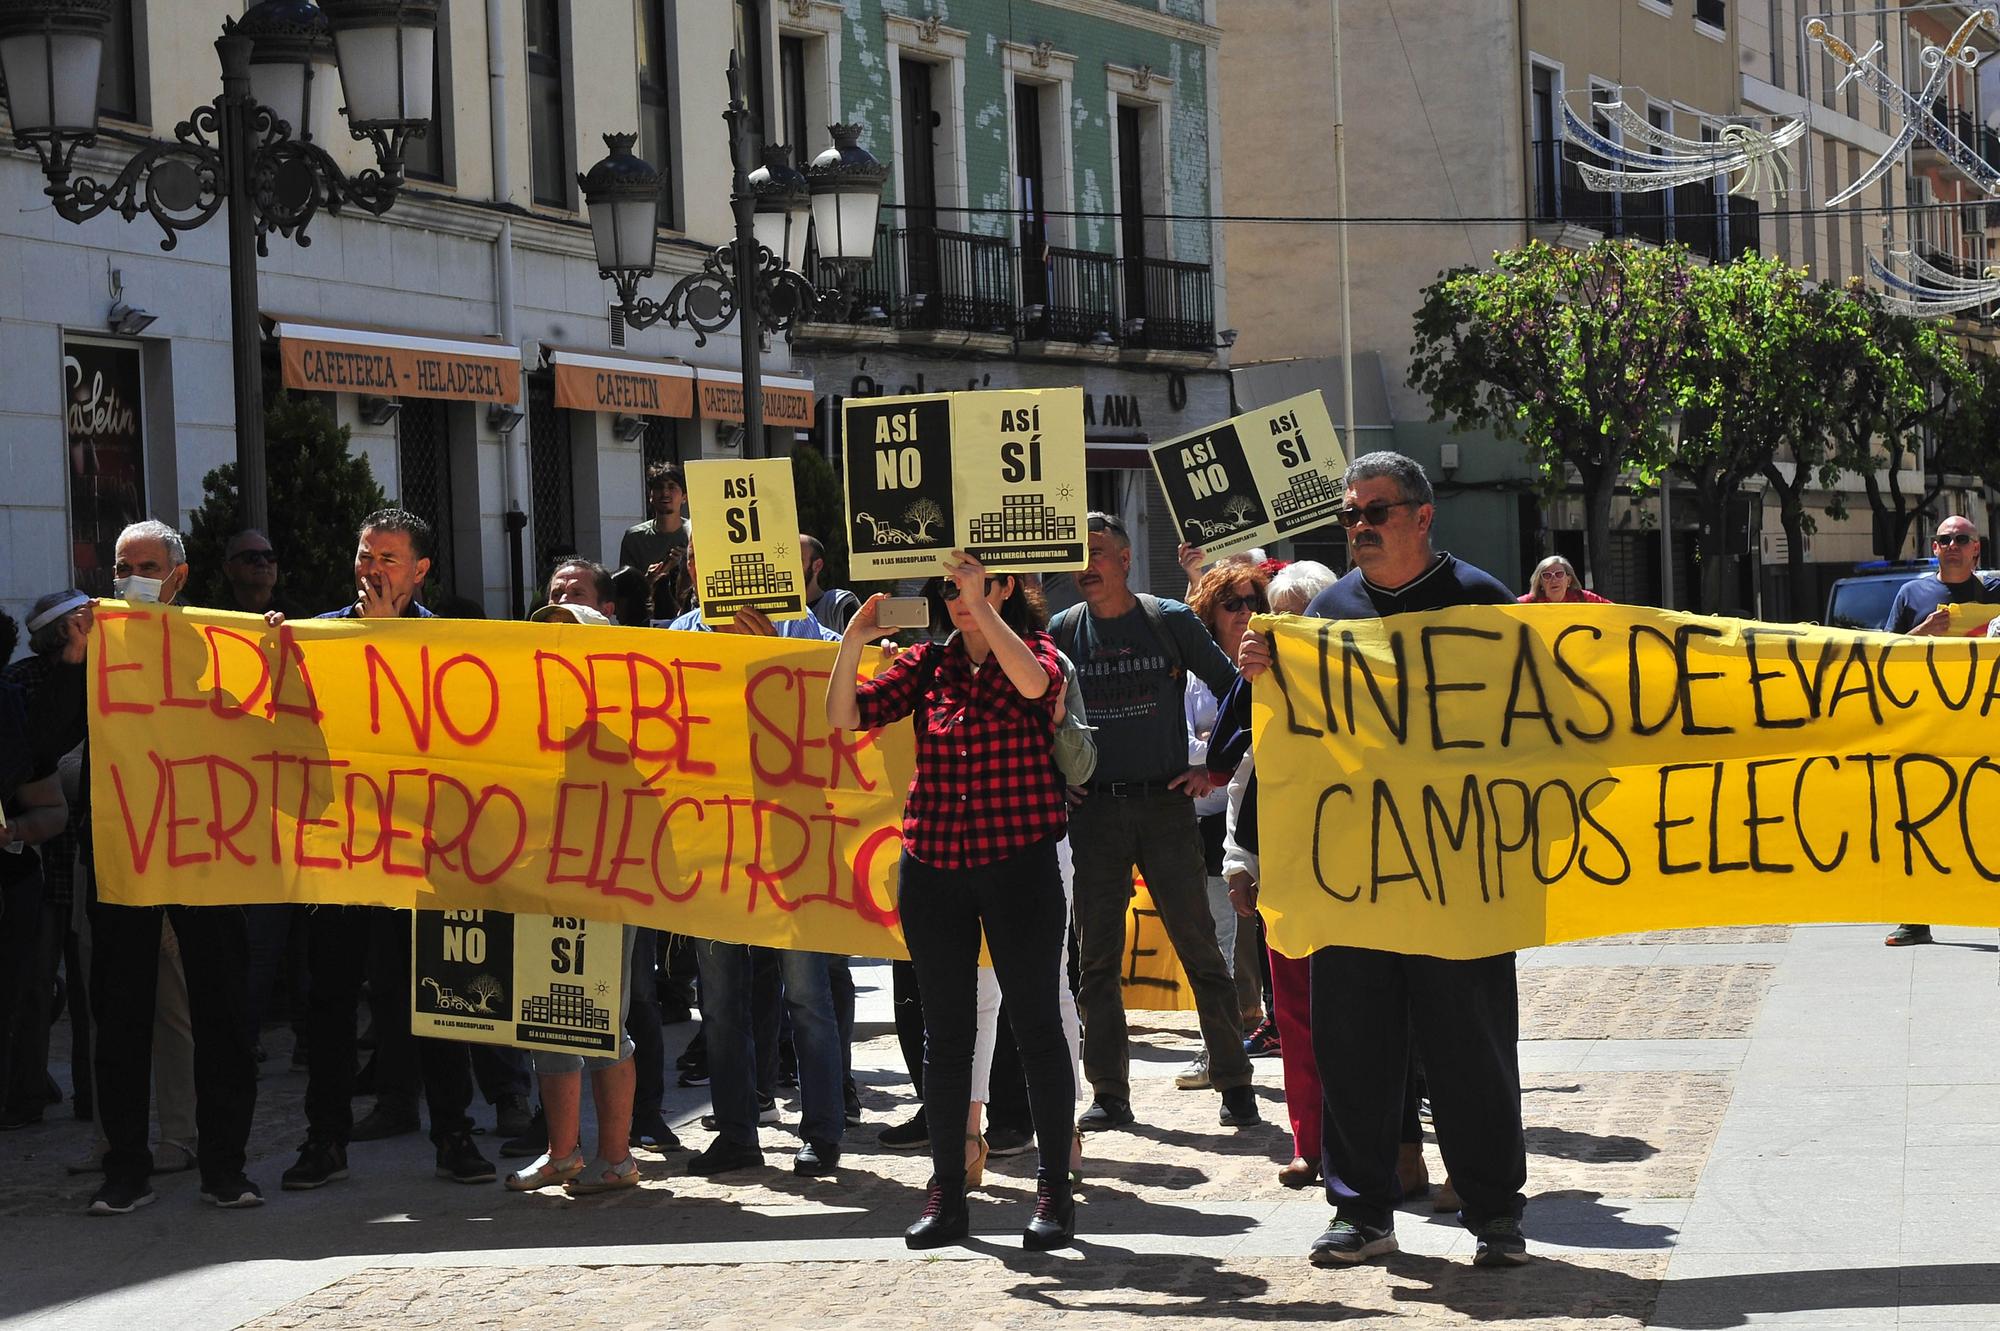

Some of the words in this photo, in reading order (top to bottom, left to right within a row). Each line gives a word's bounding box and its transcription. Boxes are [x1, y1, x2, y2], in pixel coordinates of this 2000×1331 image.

[303, 350, 398, 388] CAFETERIA
[416, 359, 504, 396] HELADERIA
[596, 374, 660, 410] CAFETIN
[875, 408, 918, 444] ASÍ
[1000, 404, 1040, 433] ASÍ
[1103, 394, 1142, 428] ANA
[1269, 409, 1299, 436] ASÍ
[1000, 433, 1043, 484] SÍ
[1180, 436, 1217, 470] ASÍ
[1276, 429, 1312, 469] SÍ
[724, 473, 756, 499] ASÍ
[875, 447, 922, 491] NO
[1186, 463, 1230, 501] NO
[726, 499, 761, 544] SÍ
[895, 555, 937, 564] MACROPLANTAS
[980, 551, 987, 560] SÍ
[987, 552, 992, 560] A
[993, 552, 1000, 560] LA
[1001, 550, 1026, 559] ENERGÍA
[1027, 549, 1068, 559] COMUNITARIA
[96, 610, 325, 725] ELDA
[364, 644, 500, 752] NO
[534, 649, 722, 776] DEBE
[1629, 625, 1736, 736] DE
[110, 749, 528, 885] VERTEDERO
[1312, 774, 1631, 906] CAMPOS
[443, 925, 487, 964] NO
[551, 933, 587, 976] SÍ
